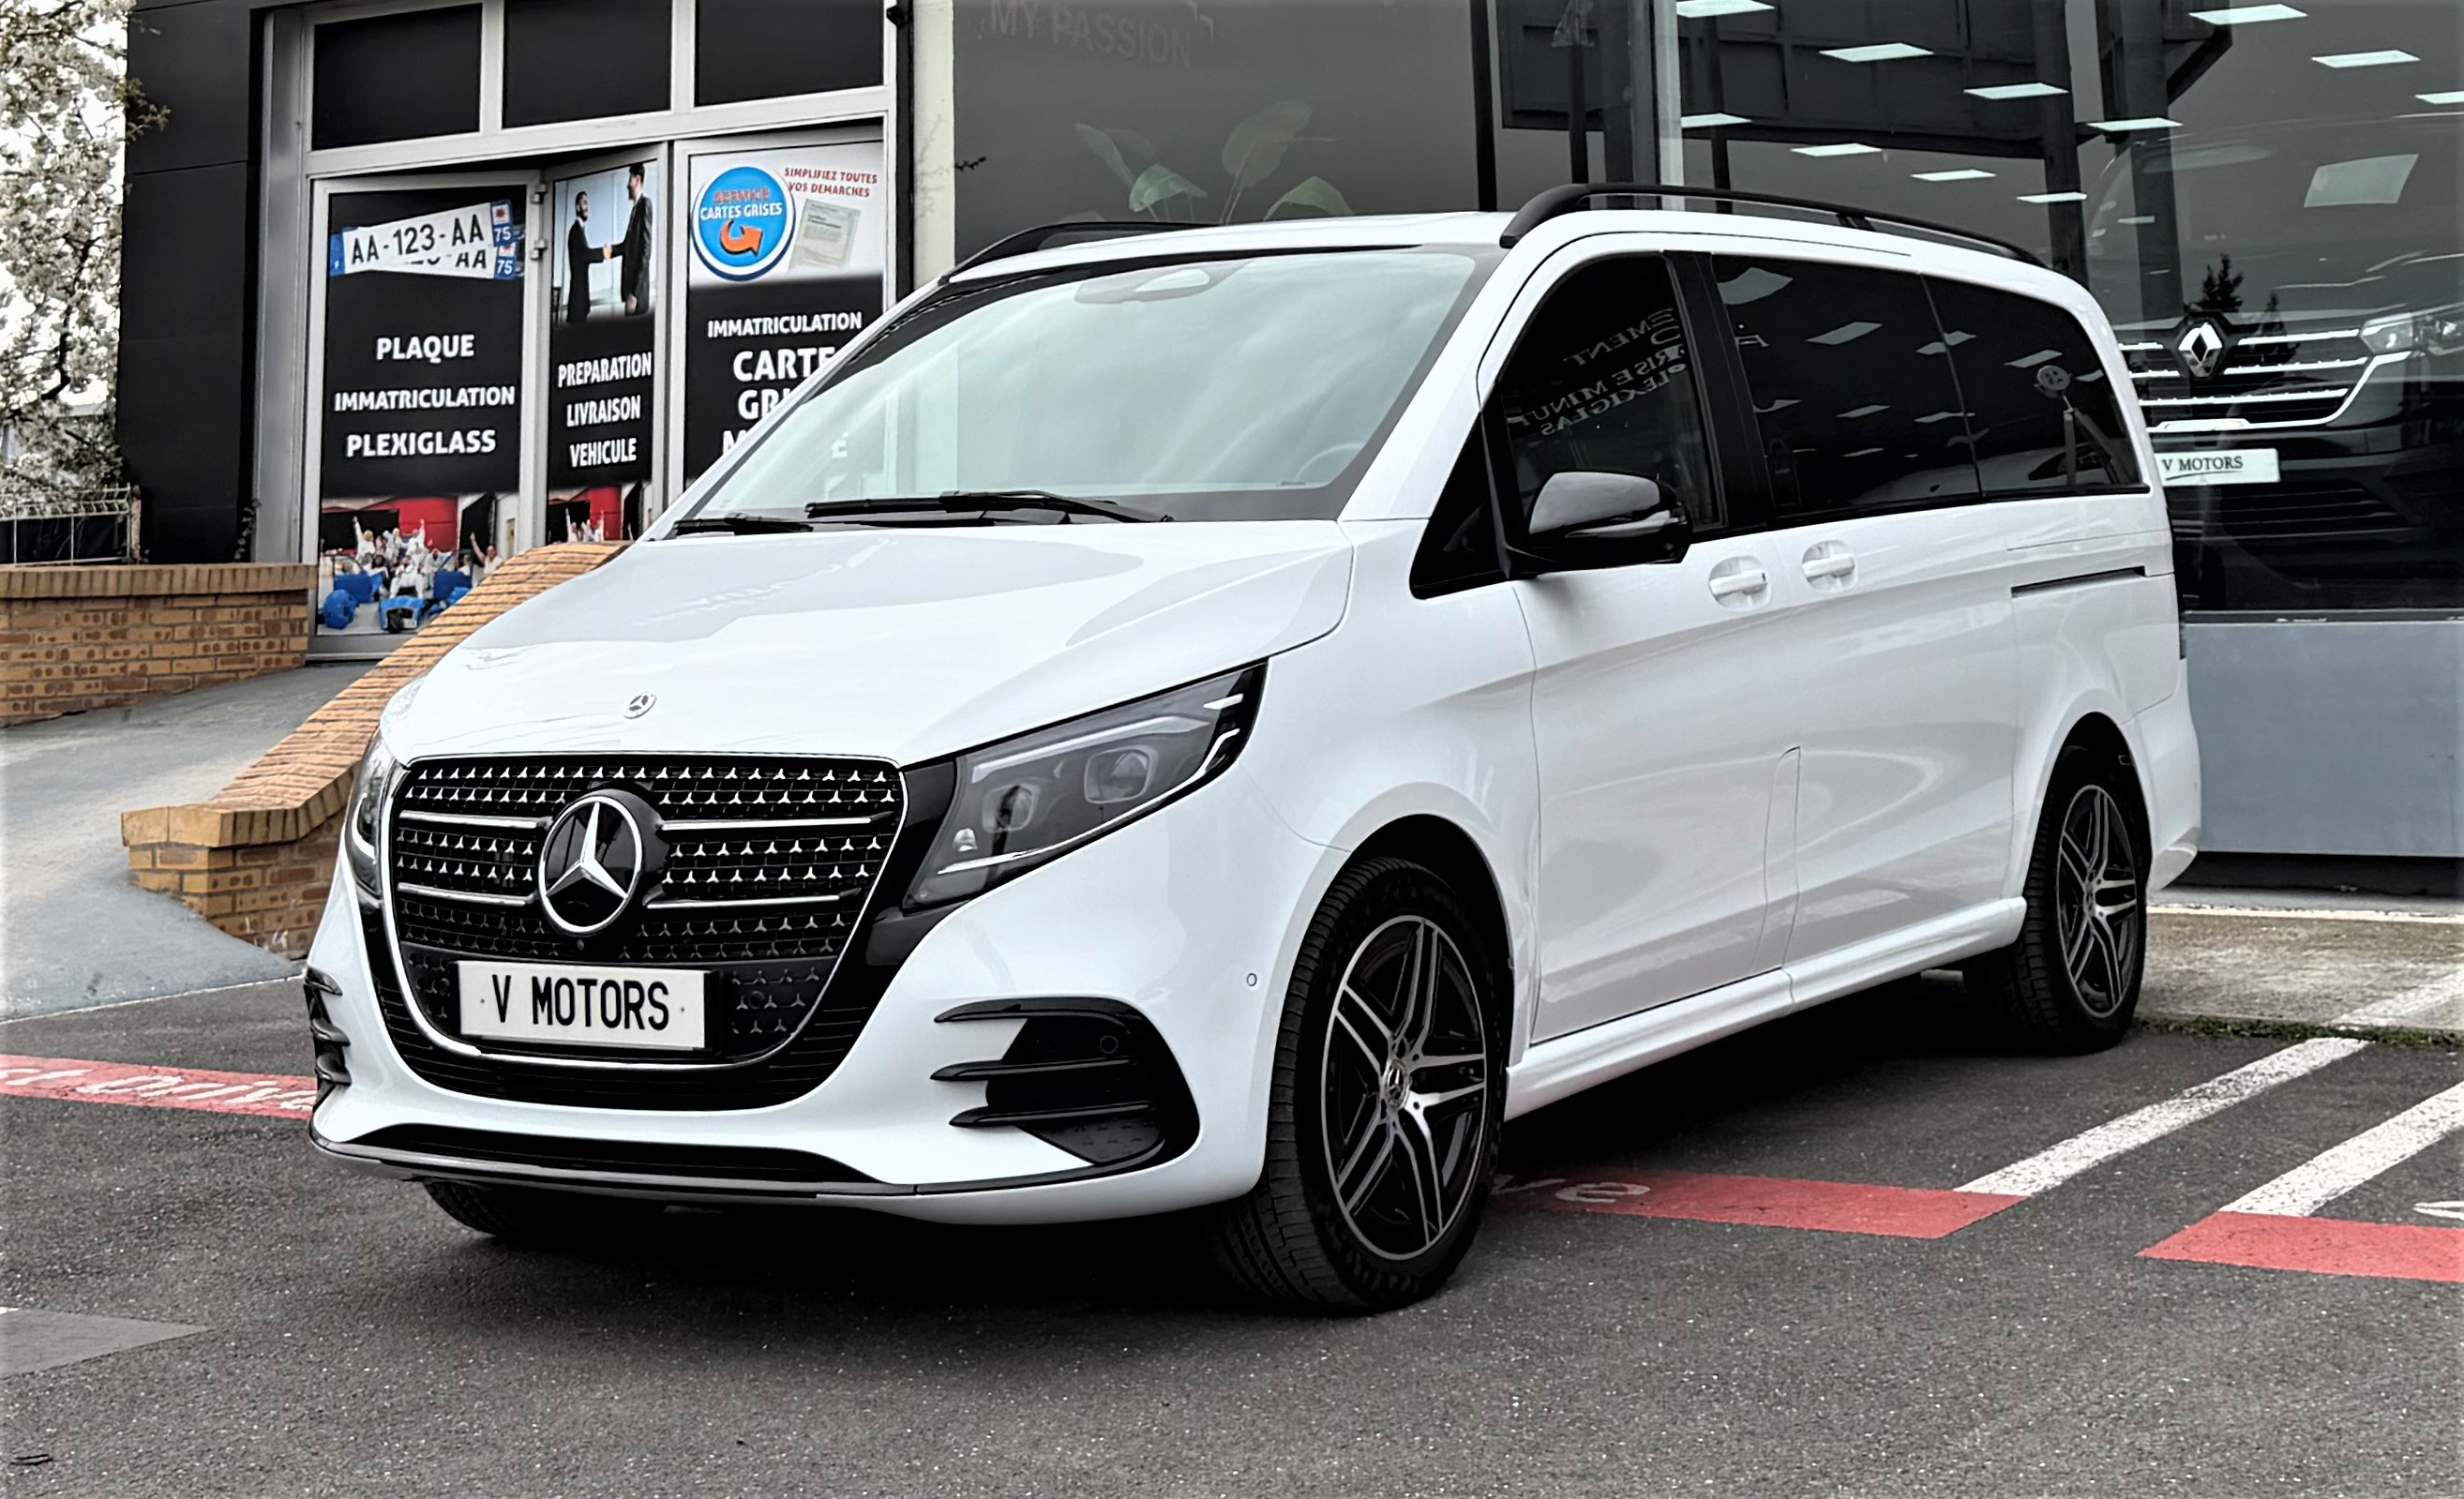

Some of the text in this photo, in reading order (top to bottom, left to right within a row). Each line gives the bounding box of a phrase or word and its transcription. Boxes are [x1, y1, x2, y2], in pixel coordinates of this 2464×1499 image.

[1052, 3, 1191, 67] PASSION
[784, 167, 878, 185] SIMPLIFIEZ TOUTES
[789, 181, 870, 199] VOS DEMARCHES
[700, 202, 783, 220] CARTES GRISES
[494, 226, 512, 242] 75
[497, 260, 513, 275] 75
[708, 311, 862, 338] IMMATRICULATION
[376, 334, 475, 364] PLAQUE
[558, 352, 652, 388] PREPARATION
[334, 385, 516, 412] IMMATRICULATION
[566, 394, 641, 427] LIVRAISON
[346, 428, 497, 457] PLEXIGLASS
[569, 437, 638, 468] VEHICULE
[2162, 456, 2244, 472] V MOTORS
[491, 974, 670, 1032] V MOTORS
